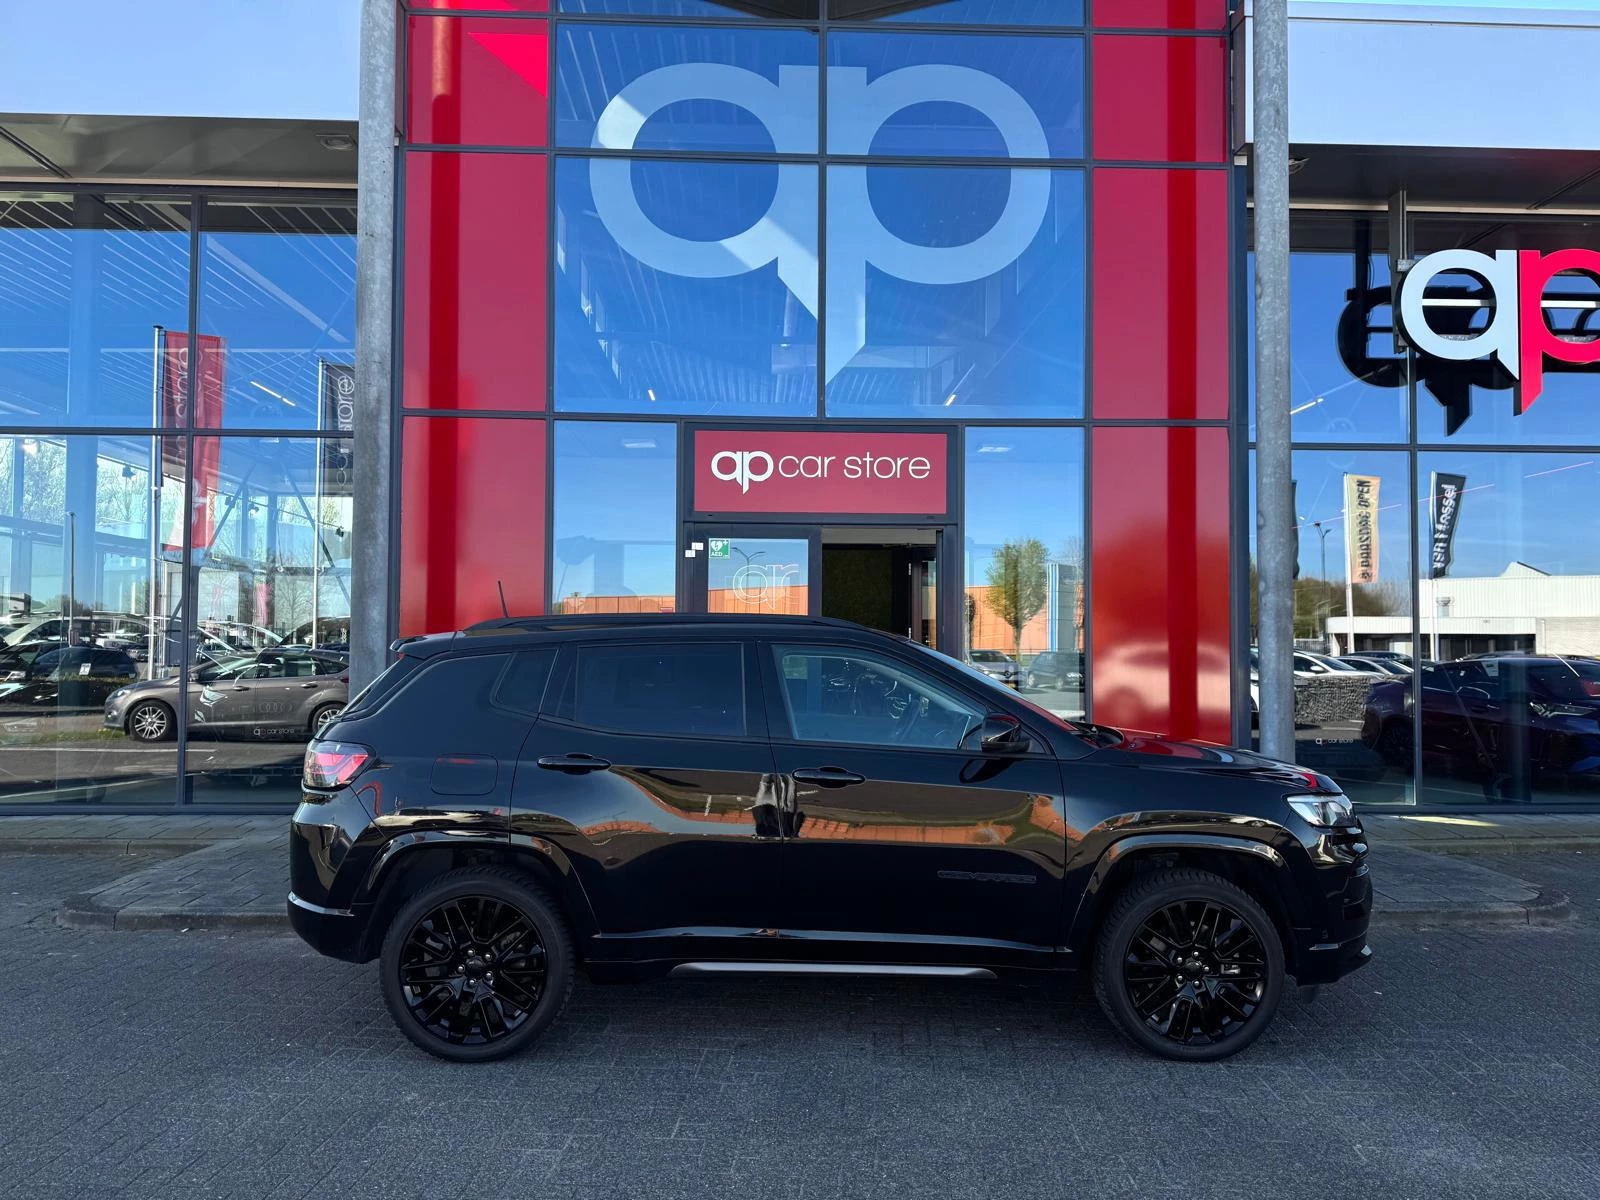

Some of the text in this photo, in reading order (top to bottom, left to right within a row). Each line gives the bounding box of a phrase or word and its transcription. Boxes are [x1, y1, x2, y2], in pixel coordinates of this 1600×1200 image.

[711, 451, 931, 495] ap car store
[1357, 479, 1371, 508] OPEN
[1434, 484, 1457, 539] Mossel
